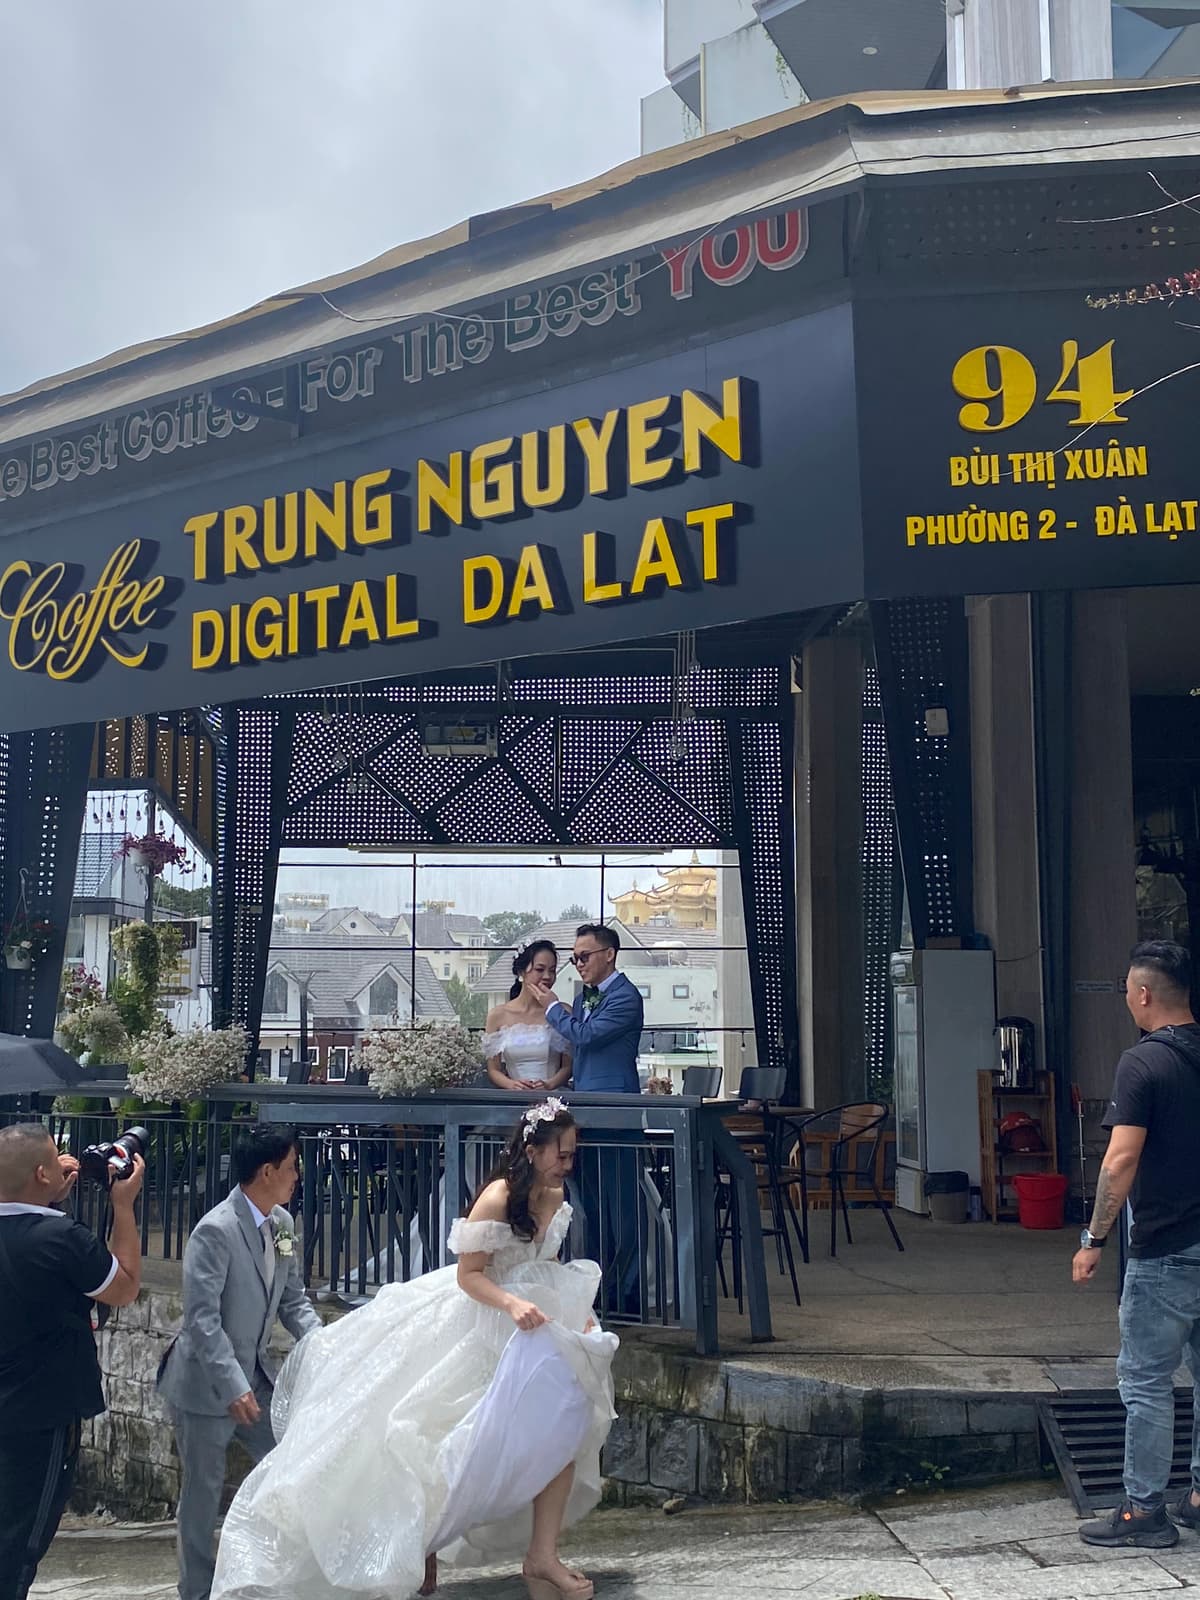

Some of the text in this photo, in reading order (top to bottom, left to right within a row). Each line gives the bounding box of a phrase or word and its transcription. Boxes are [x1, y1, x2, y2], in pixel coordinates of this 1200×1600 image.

[0, 458, 27, 498] e
[30, 437, 119, 491] Best
[122, 386, 262, 462] Coffee
[300, 346, 384, 413] For
[392, 308, 495, 384] The
[505, 259, 643, 352] Best
[660, 207, 809, 300] YOU
[951, 339, 1135, 432] 94
[183, 378, 741, 580] TRUNG NGUYEN
[906, 503, 1029, 546] PHƯỜNG
[1038, 509, 1057, 540] 2
[1094, 495, 1138, 536] ĐÀ
[1145, 500, 1199, 541] LẠT
[949, 438, 1148, 489] BÙI THỊ XUÂN
[0, 538, 165, 680] Coffee
[191, 502, 734, 670] DIGITAL DA LAT
